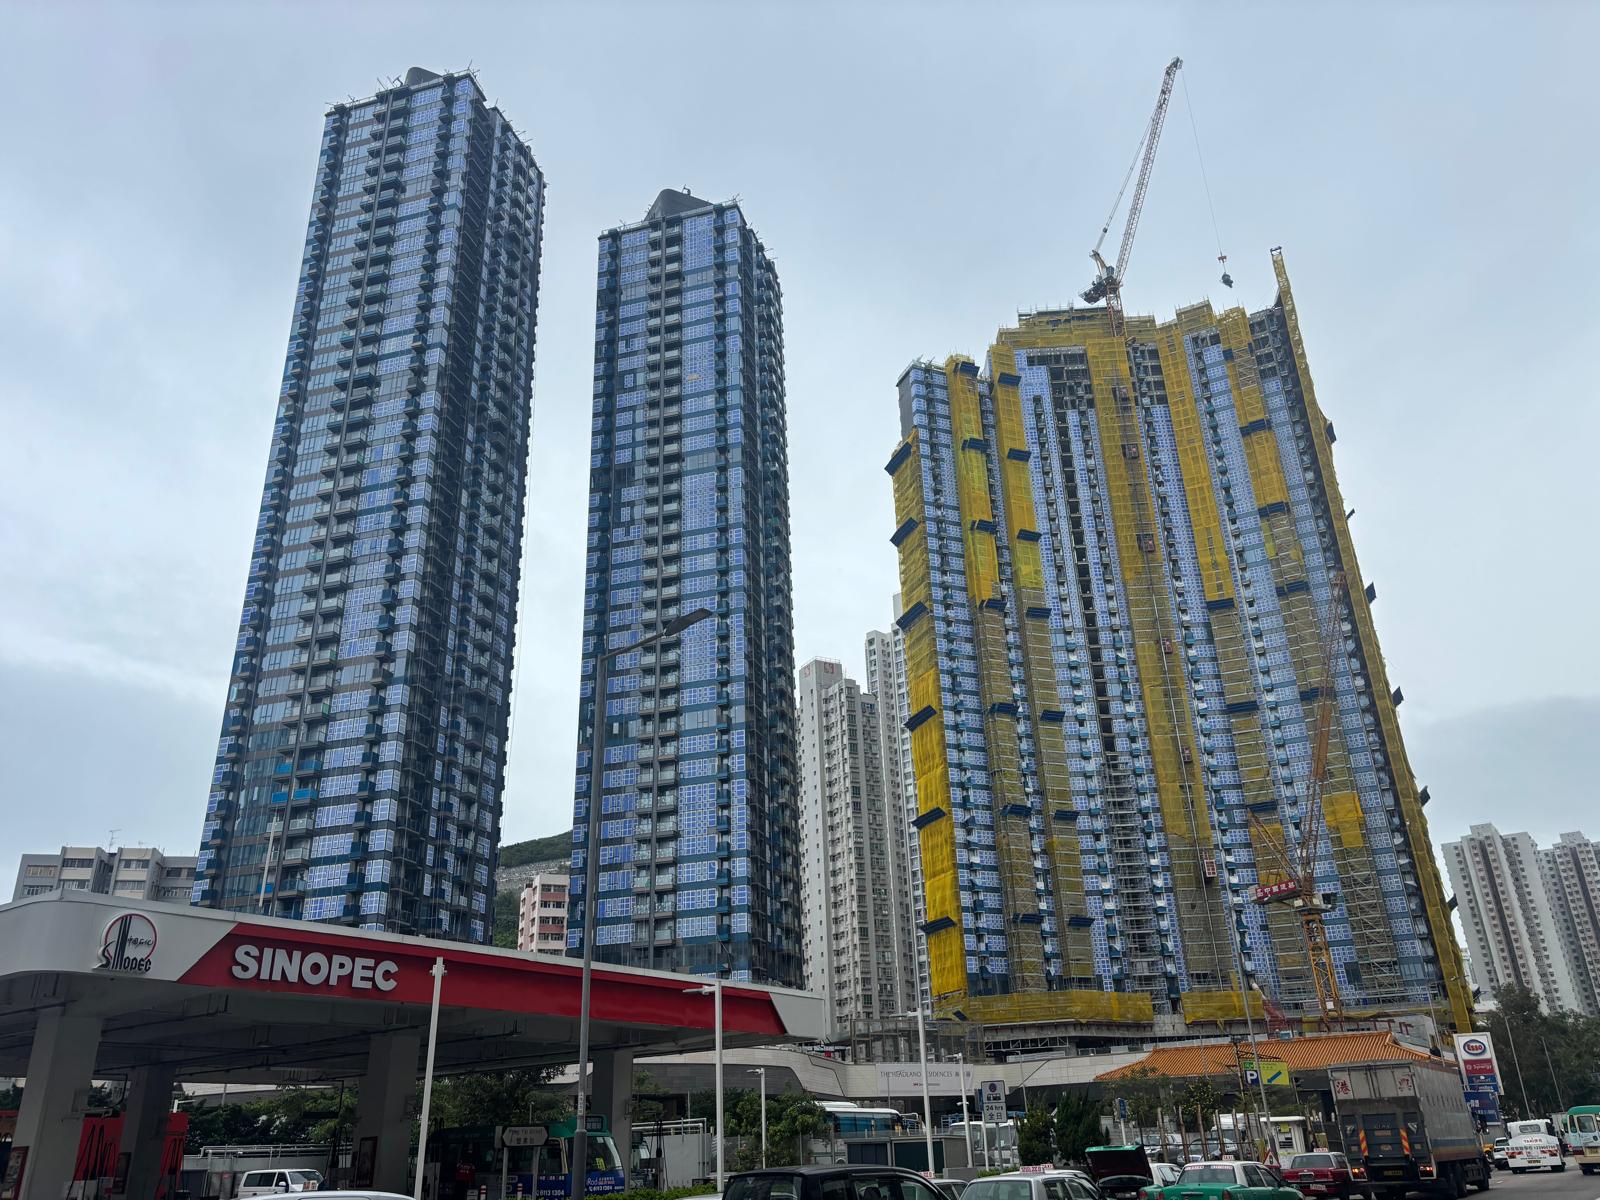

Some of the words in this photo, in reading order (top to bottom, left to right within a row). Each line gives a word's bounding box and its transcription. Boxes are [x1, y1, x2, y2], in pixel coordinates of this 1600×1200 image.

[231, 944, 399, 992] SINOPEC
[1246, 1070, 1258, 1084] P
[1336, 1080, 1351, 1095] 港
[988, 1112, 1003, 1120] 全日
